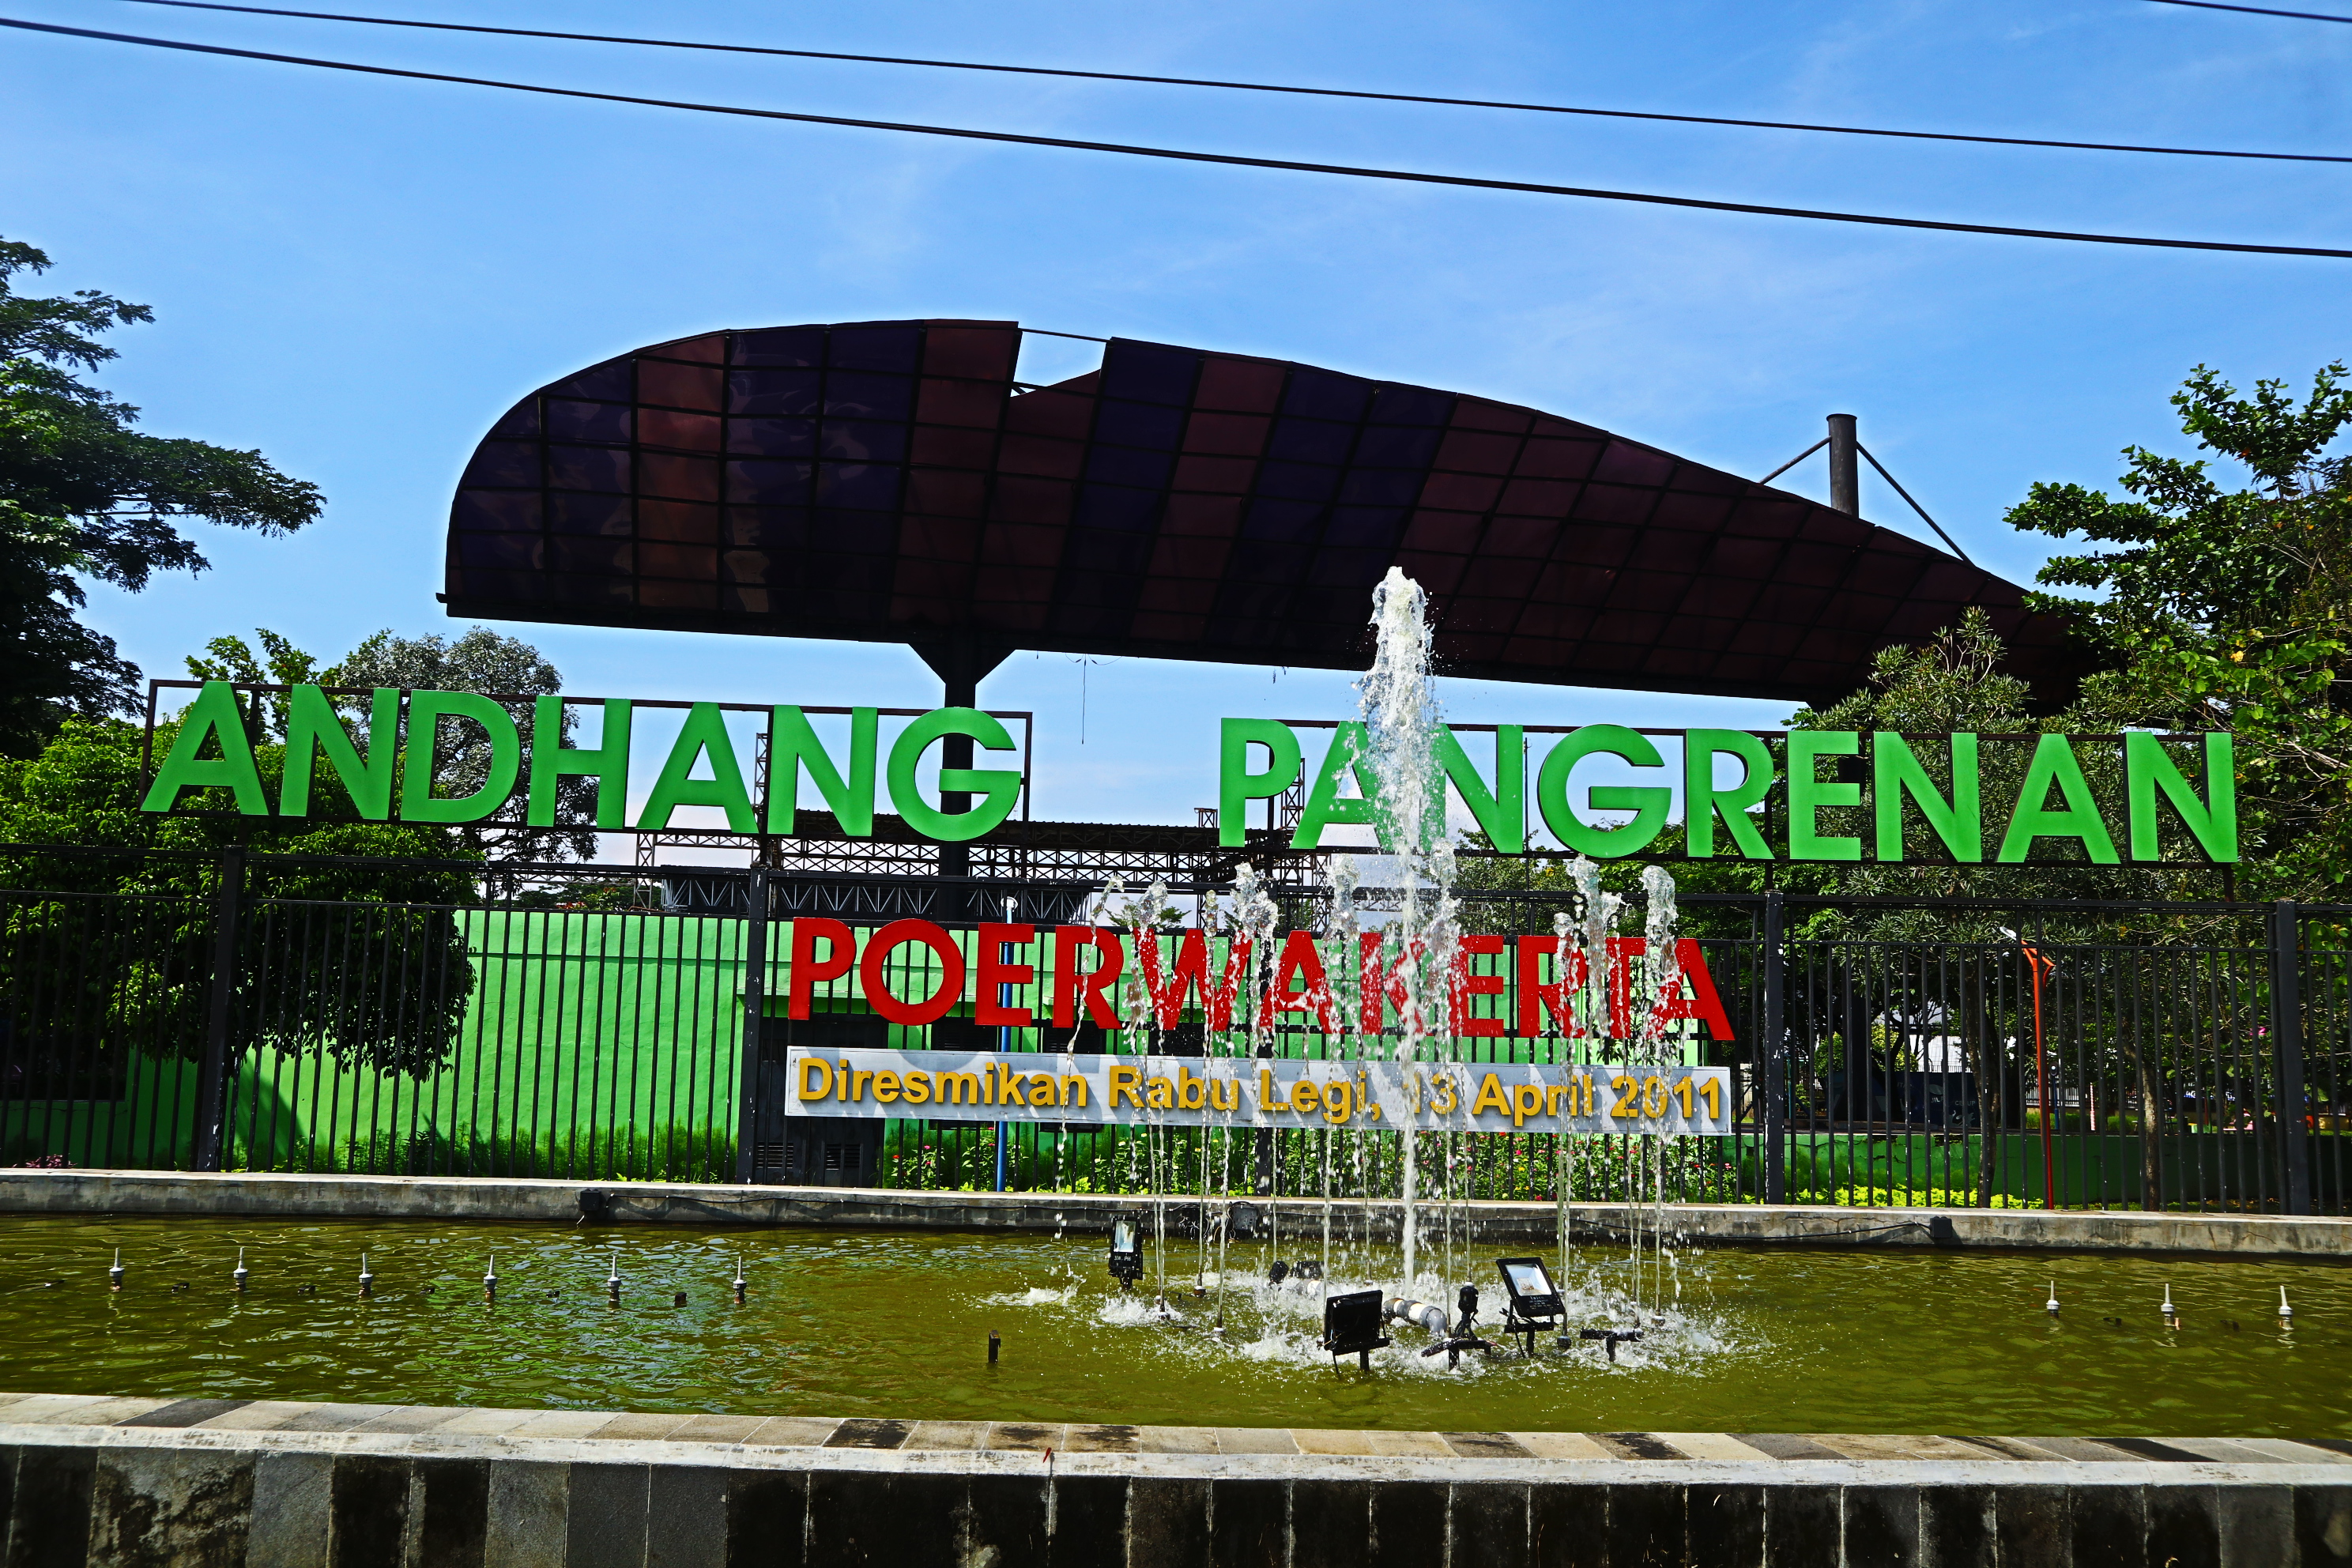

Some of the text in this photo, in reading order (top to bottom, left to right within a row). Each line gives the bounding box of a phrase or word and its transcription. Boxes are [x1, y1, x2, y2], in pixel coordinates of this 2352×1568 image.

[141, 680, 2239, 863] ANDHANG PANGRENAN
[787, 917, 1736, 1041] POERWAKERTA
[797, 1057, 1720, 1126] Diresmikan Rabu Legi, 13 April 2011
